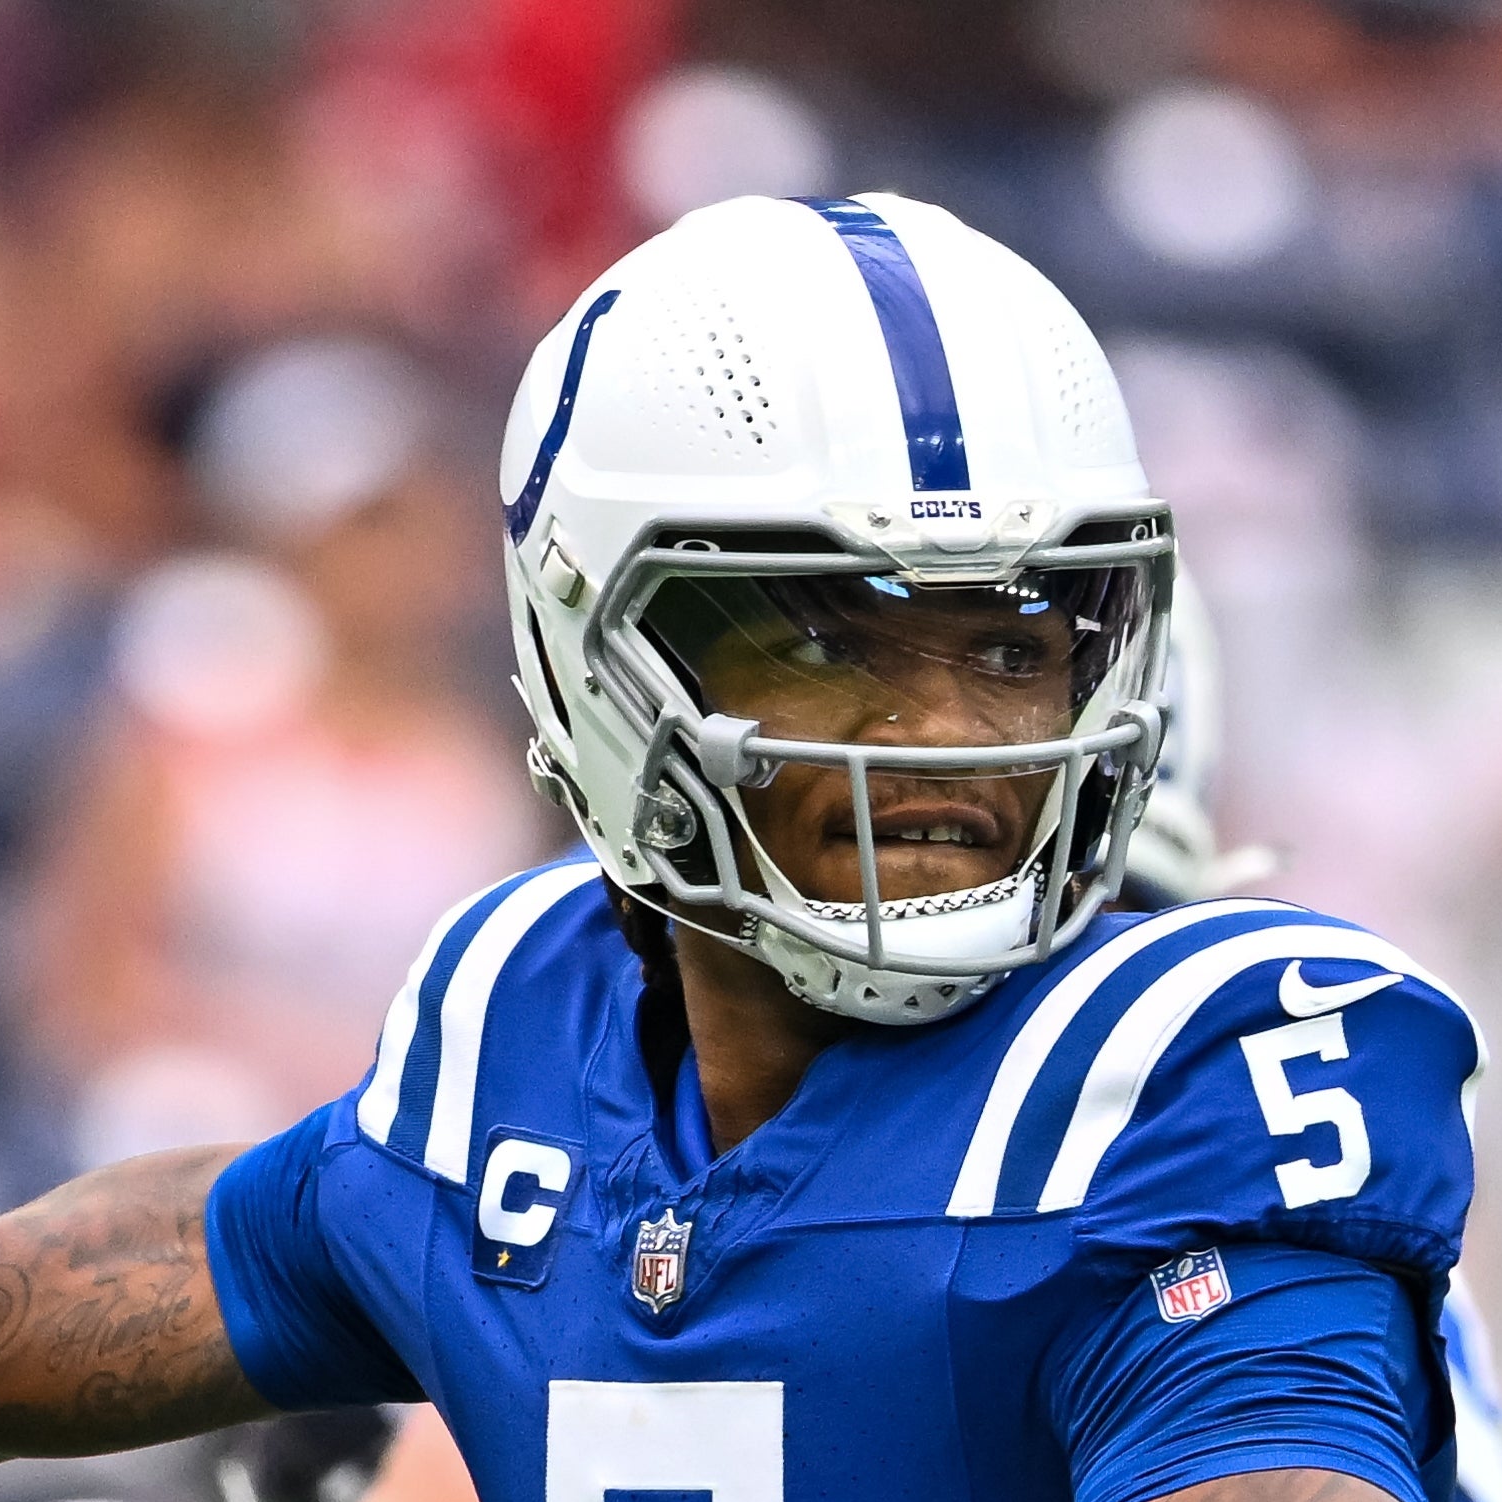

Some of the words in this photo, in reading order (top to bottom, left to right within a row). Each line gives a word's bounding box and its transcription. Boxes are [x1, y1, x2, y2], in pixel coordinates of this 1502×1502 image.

[910, 500, 982, 519] COLTS
[1239, 1012, 1372, 1210] 5
[478, 1138, 572, 1247] C
[641, 1258, 674, 1295] NFL
[1164, 1271, 1221, 1315] NFL
